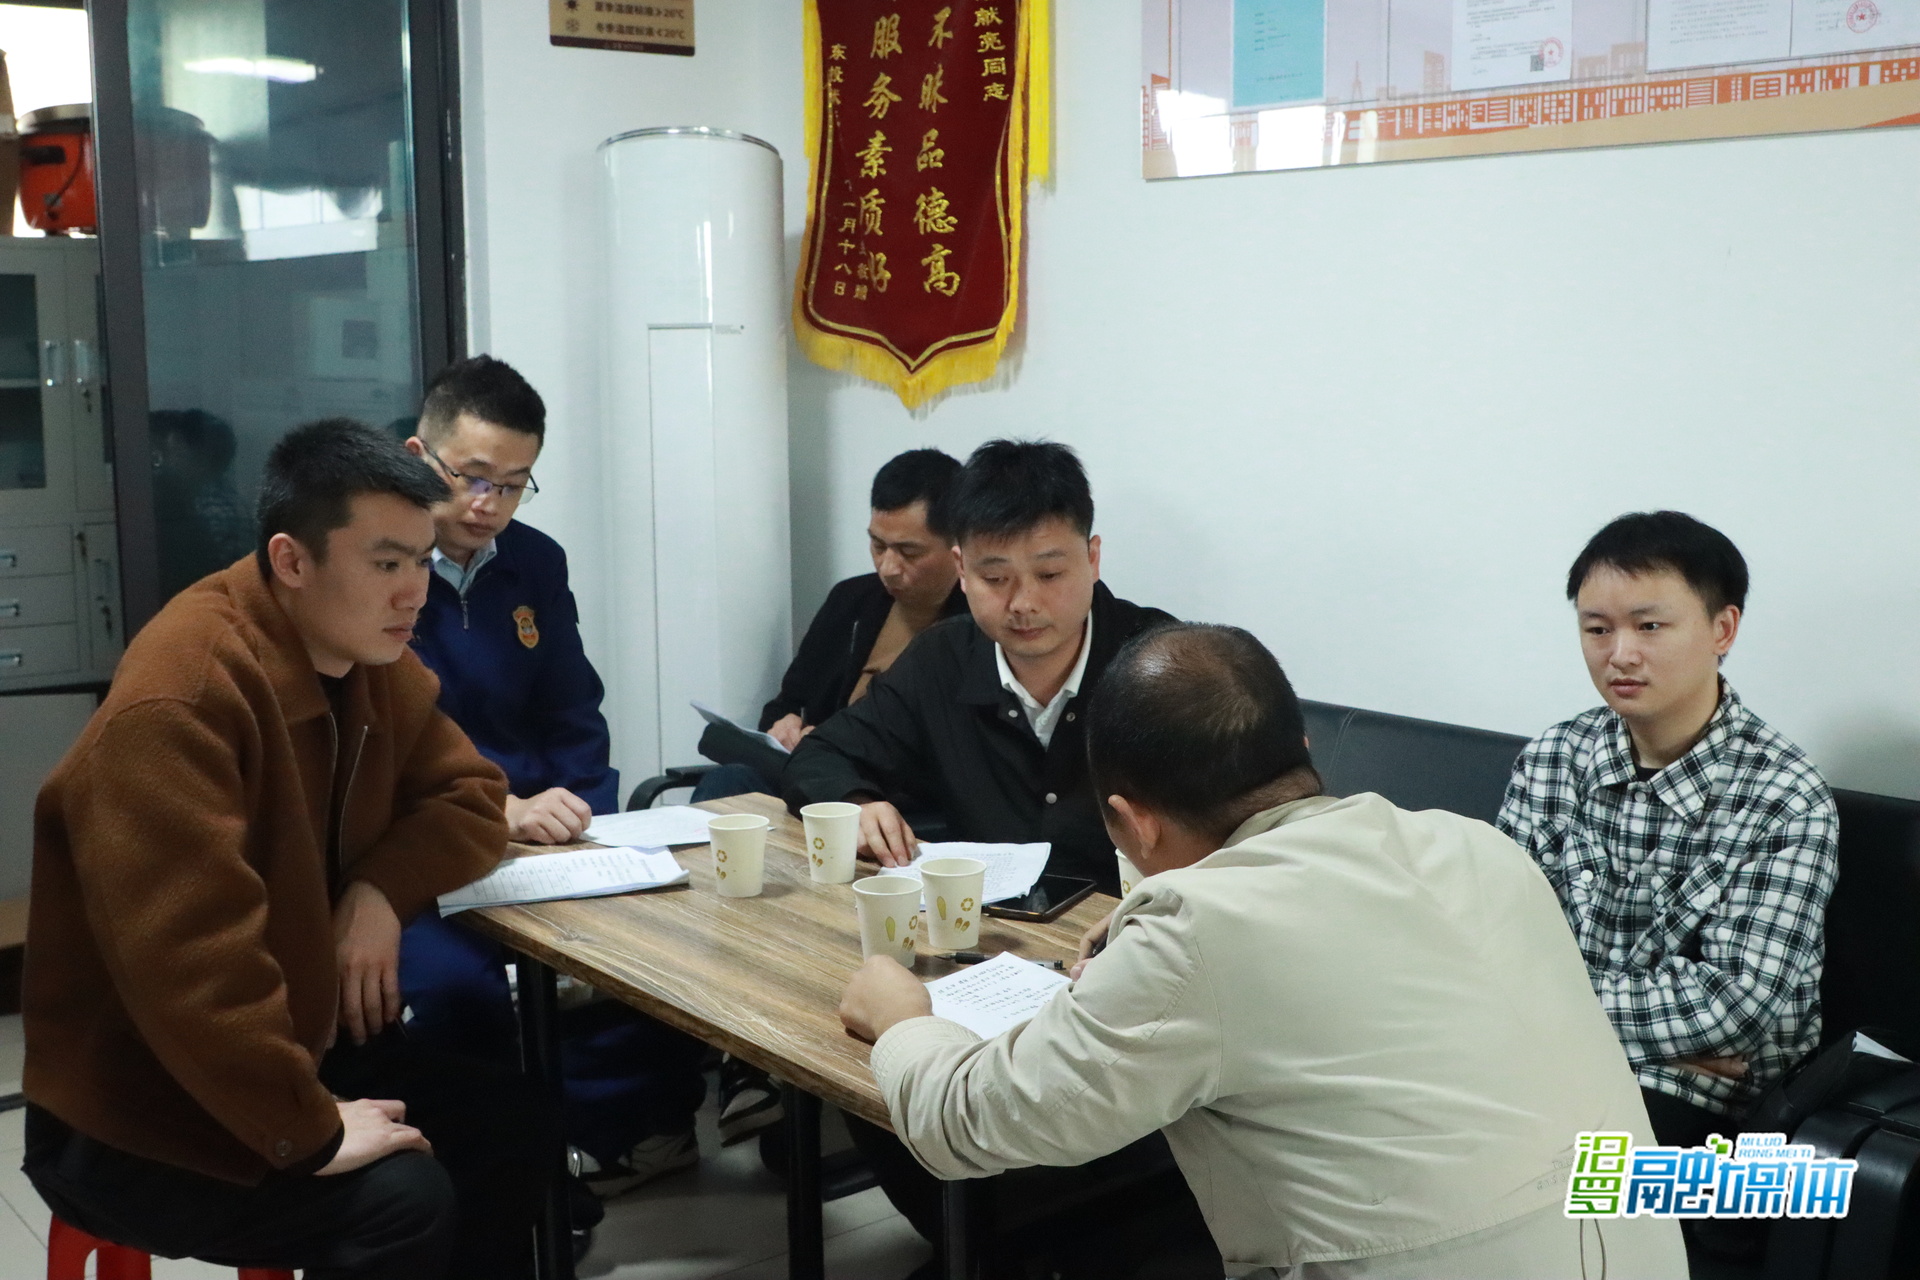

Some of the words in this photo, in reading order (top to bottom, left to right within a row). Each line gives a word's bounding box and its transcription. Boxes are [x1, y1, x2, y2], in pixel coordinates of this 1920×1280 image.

[834, 179, 857, 297] 一月十八日
